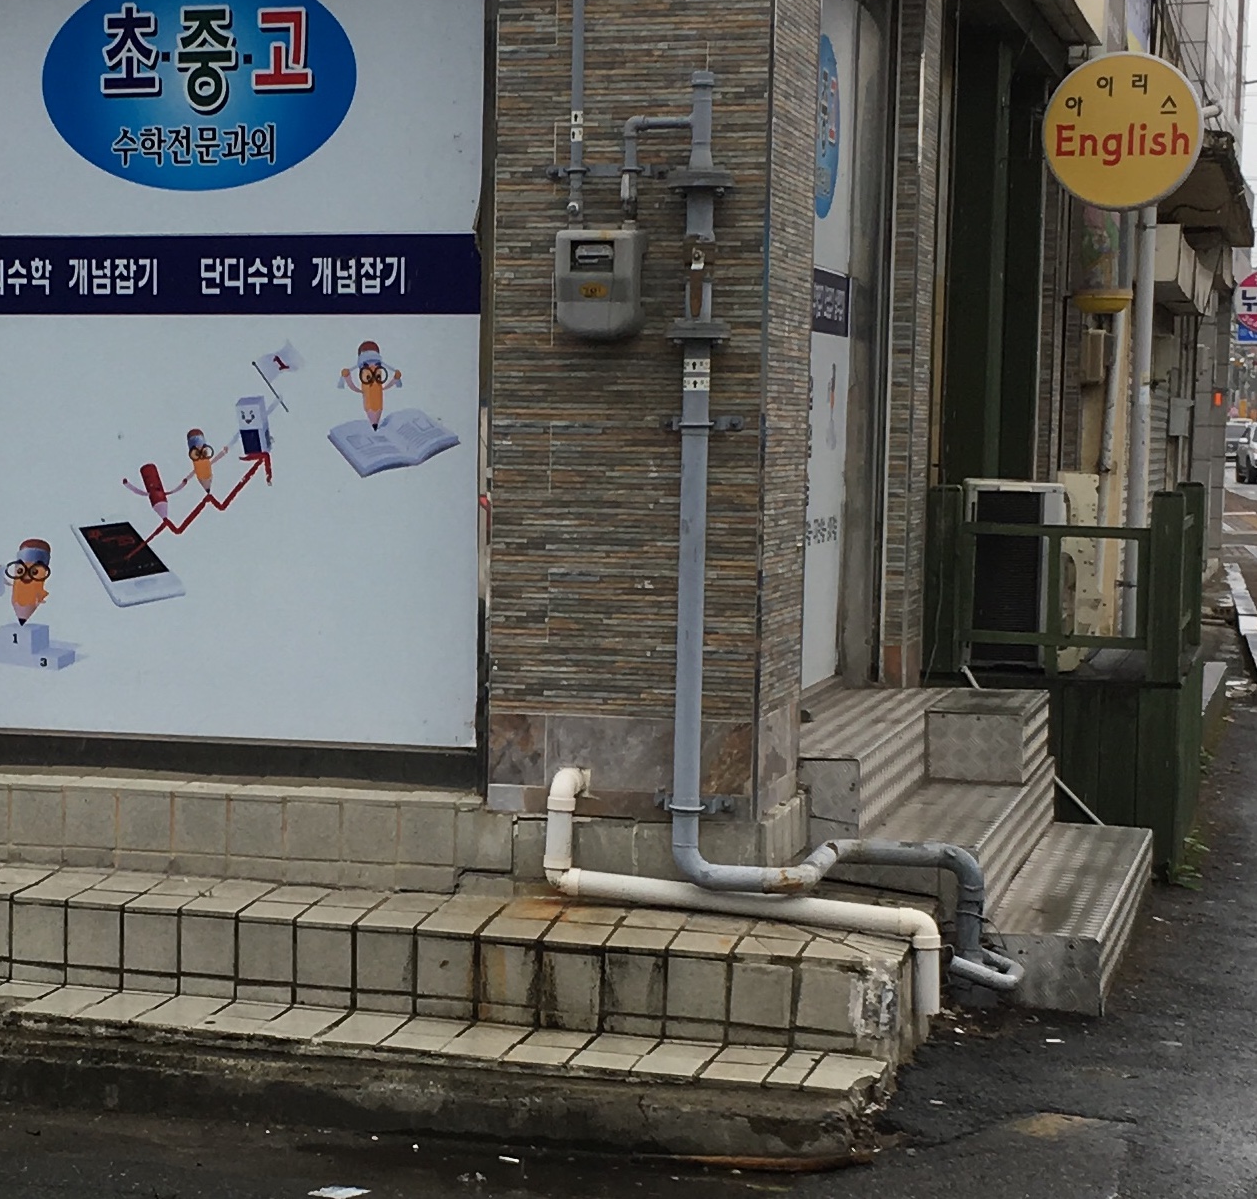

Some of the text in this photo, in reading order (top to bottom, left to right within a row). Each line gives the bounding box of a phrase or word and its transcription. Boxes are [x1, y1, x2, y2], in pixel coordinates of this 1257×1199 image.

[111, 123, 276, 167] 수학전문과외
[1056, 123, 1189, 166] English
[69, 259, 157, 295] 개념잡기
[201, 256, 294, 295] 단디수학
[312, 257, 405, 294] 개념잡기
